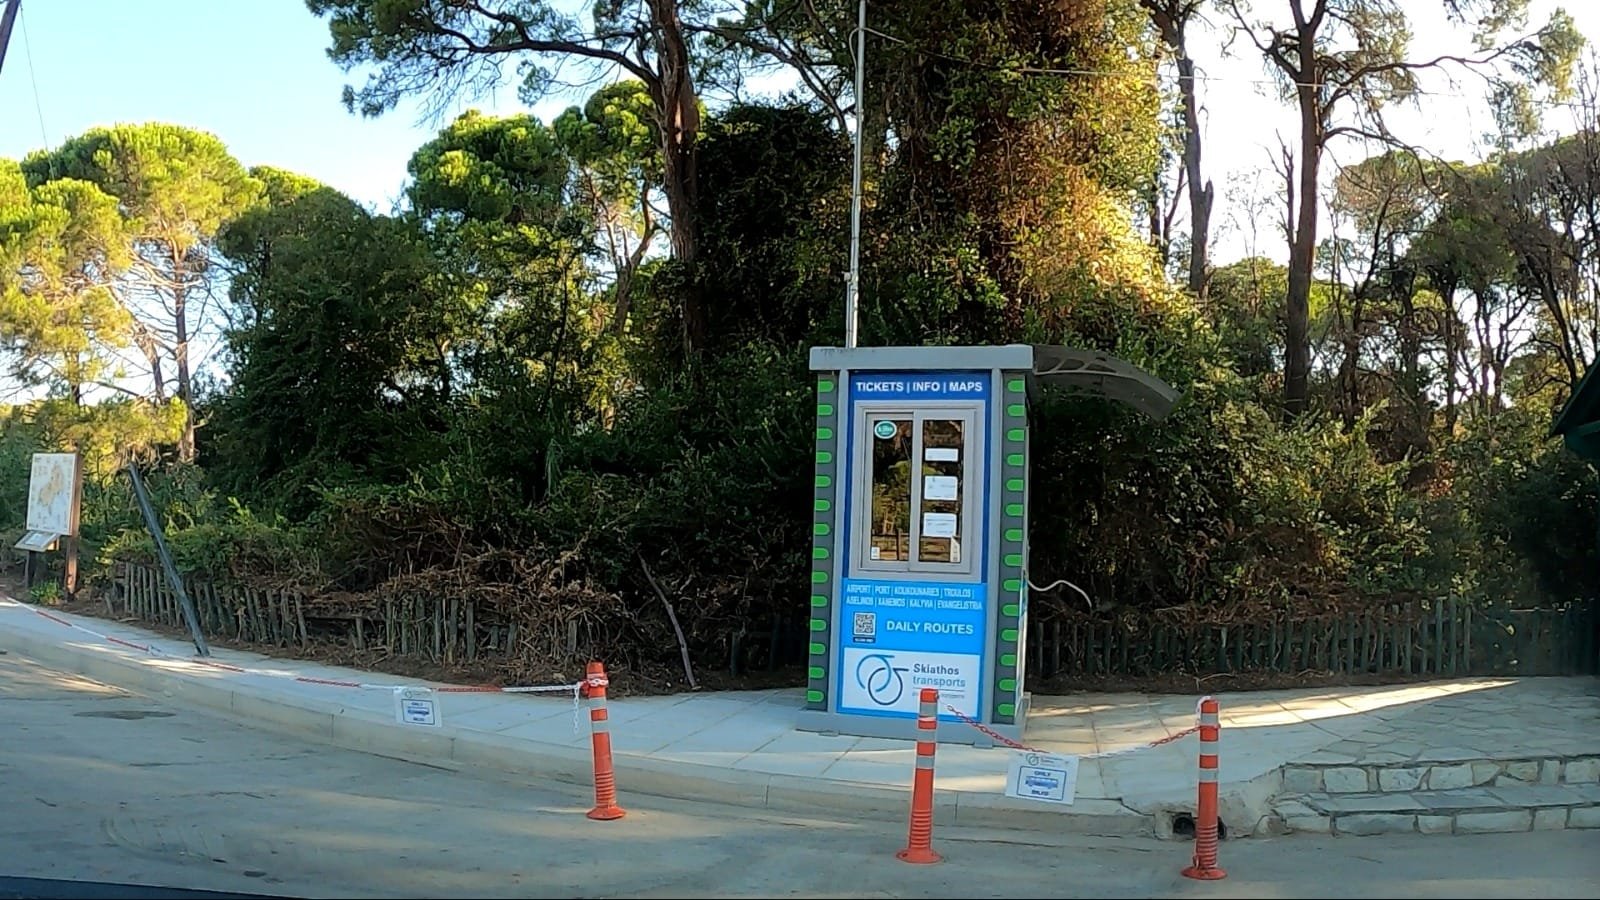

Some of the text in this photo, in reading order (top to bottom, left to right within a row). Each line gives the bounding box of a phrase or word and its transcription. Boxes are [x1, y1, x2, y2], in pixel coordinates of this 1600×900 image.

[856, 381, 904, 392] TICKETS
[913, 382, 940, 392] INFO
[949, 382, 983, 392] MAPS
[846, 584, 871, 594] AIRPORT
[875, 585, 890, 595] PORT
[887, 620, 974, 635] DAILY ROUTES
[913, 663, 960, 676] Skiathos
[912, 676, 967, 688] transports
